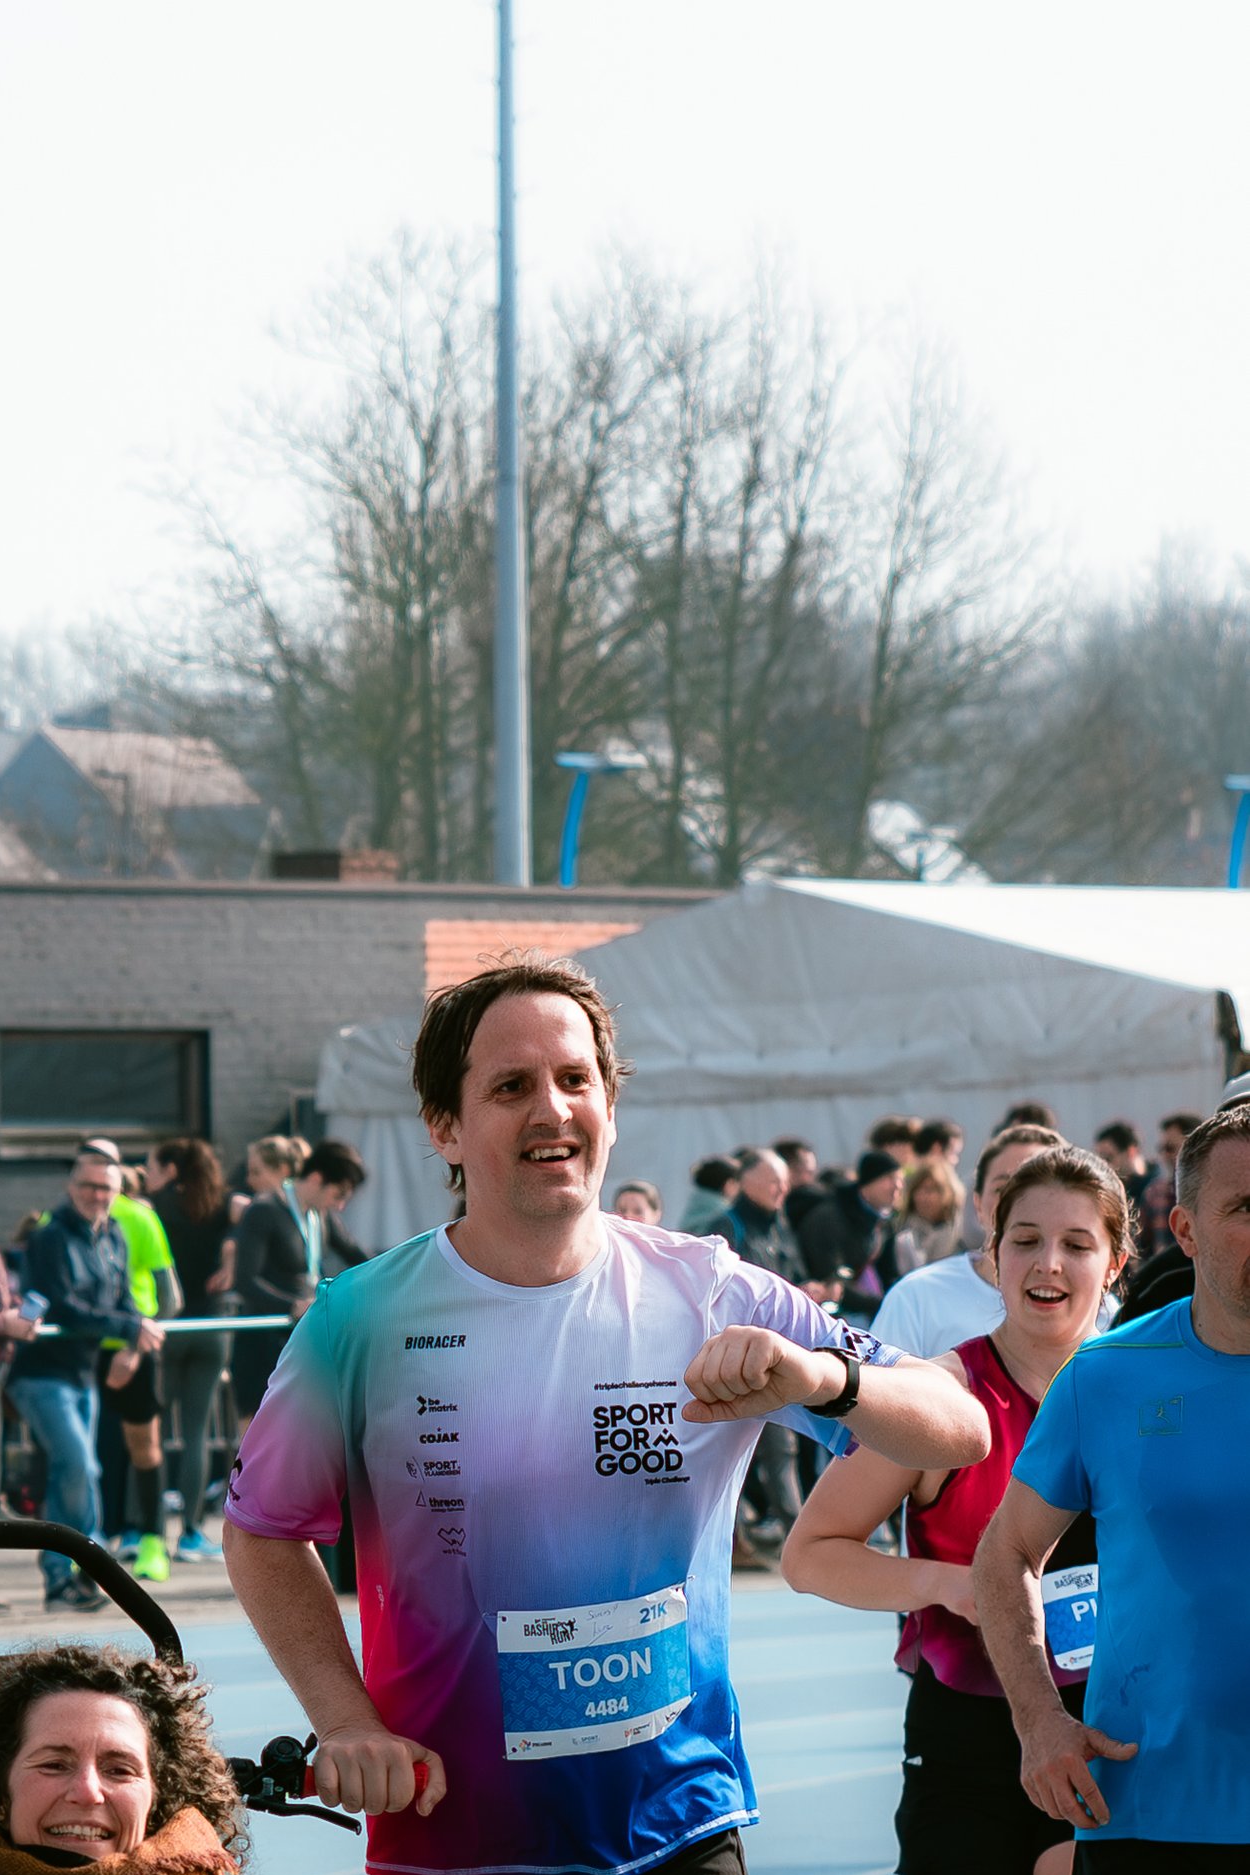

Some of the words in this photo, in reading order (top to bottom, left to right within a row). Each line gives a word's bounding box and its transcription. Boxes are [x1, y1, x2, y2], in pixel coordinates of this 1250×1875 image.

[405, 1335, 467, 1350] BIORACER
[428, 1398, 440, 1406] be
[429, 1404, 458, 1413] matrix
[593, 1402, 678, 1429] SPORT
[595, 1427, 651, 1454] FOR
[595, 1448, 684, 1477] GOOD
[429, 1497, 464, 1507] threon
[639, 1600, 667, 1625] 21K
[548, 1647, 652, 1690] TOON
[585, 1696, 629, 1718] 4484
